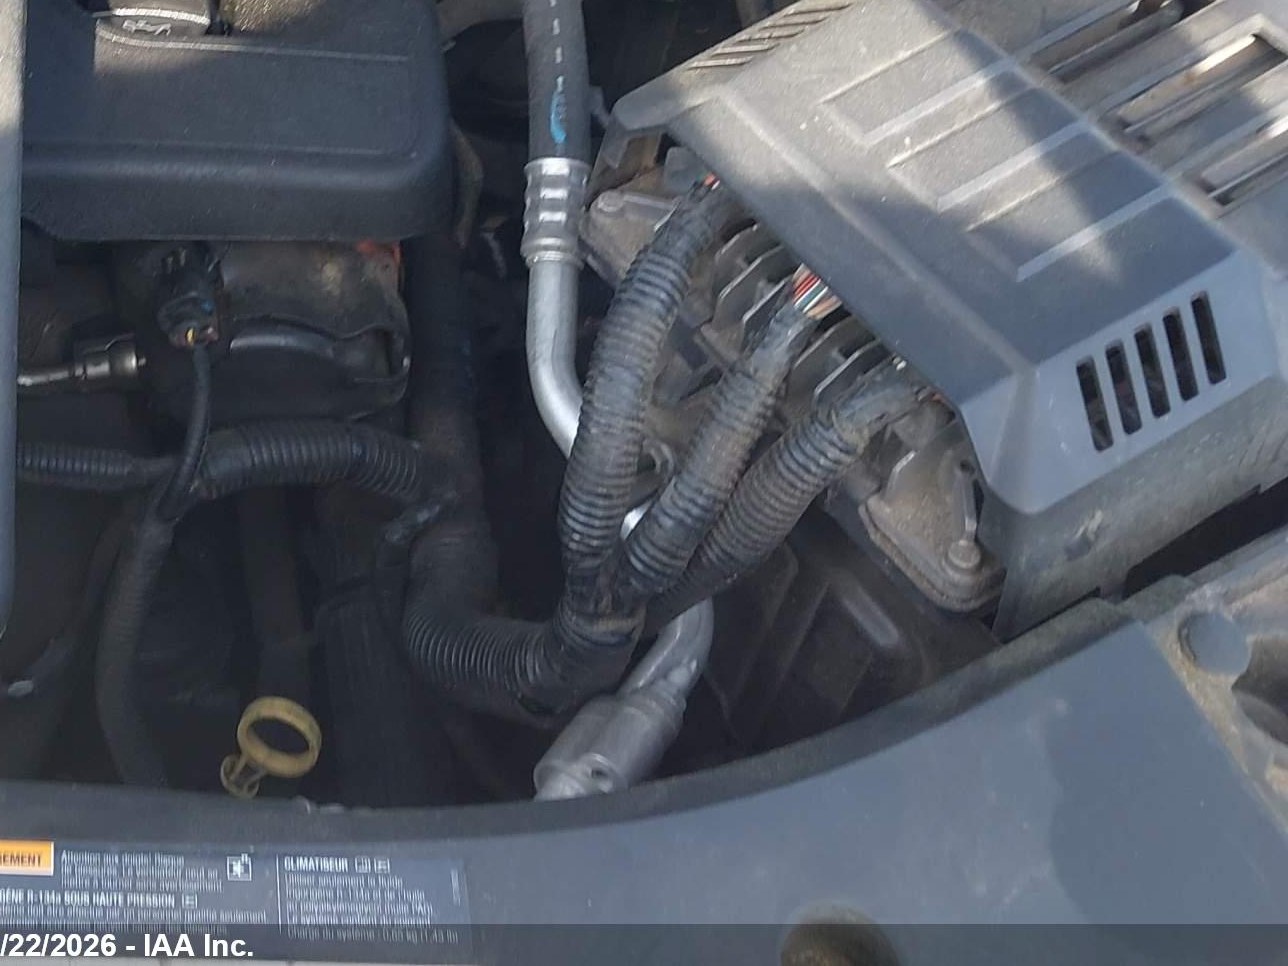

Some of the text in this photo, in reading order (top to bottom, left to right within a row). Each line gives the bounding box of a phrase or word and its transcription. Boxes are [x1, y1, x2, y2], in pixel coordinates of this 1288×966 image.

[284, 856, 348, 872] CLIMATISEUR
[92, 891, 123, 907] HAUTE
[127, 892, 175, 908] PRESSION
